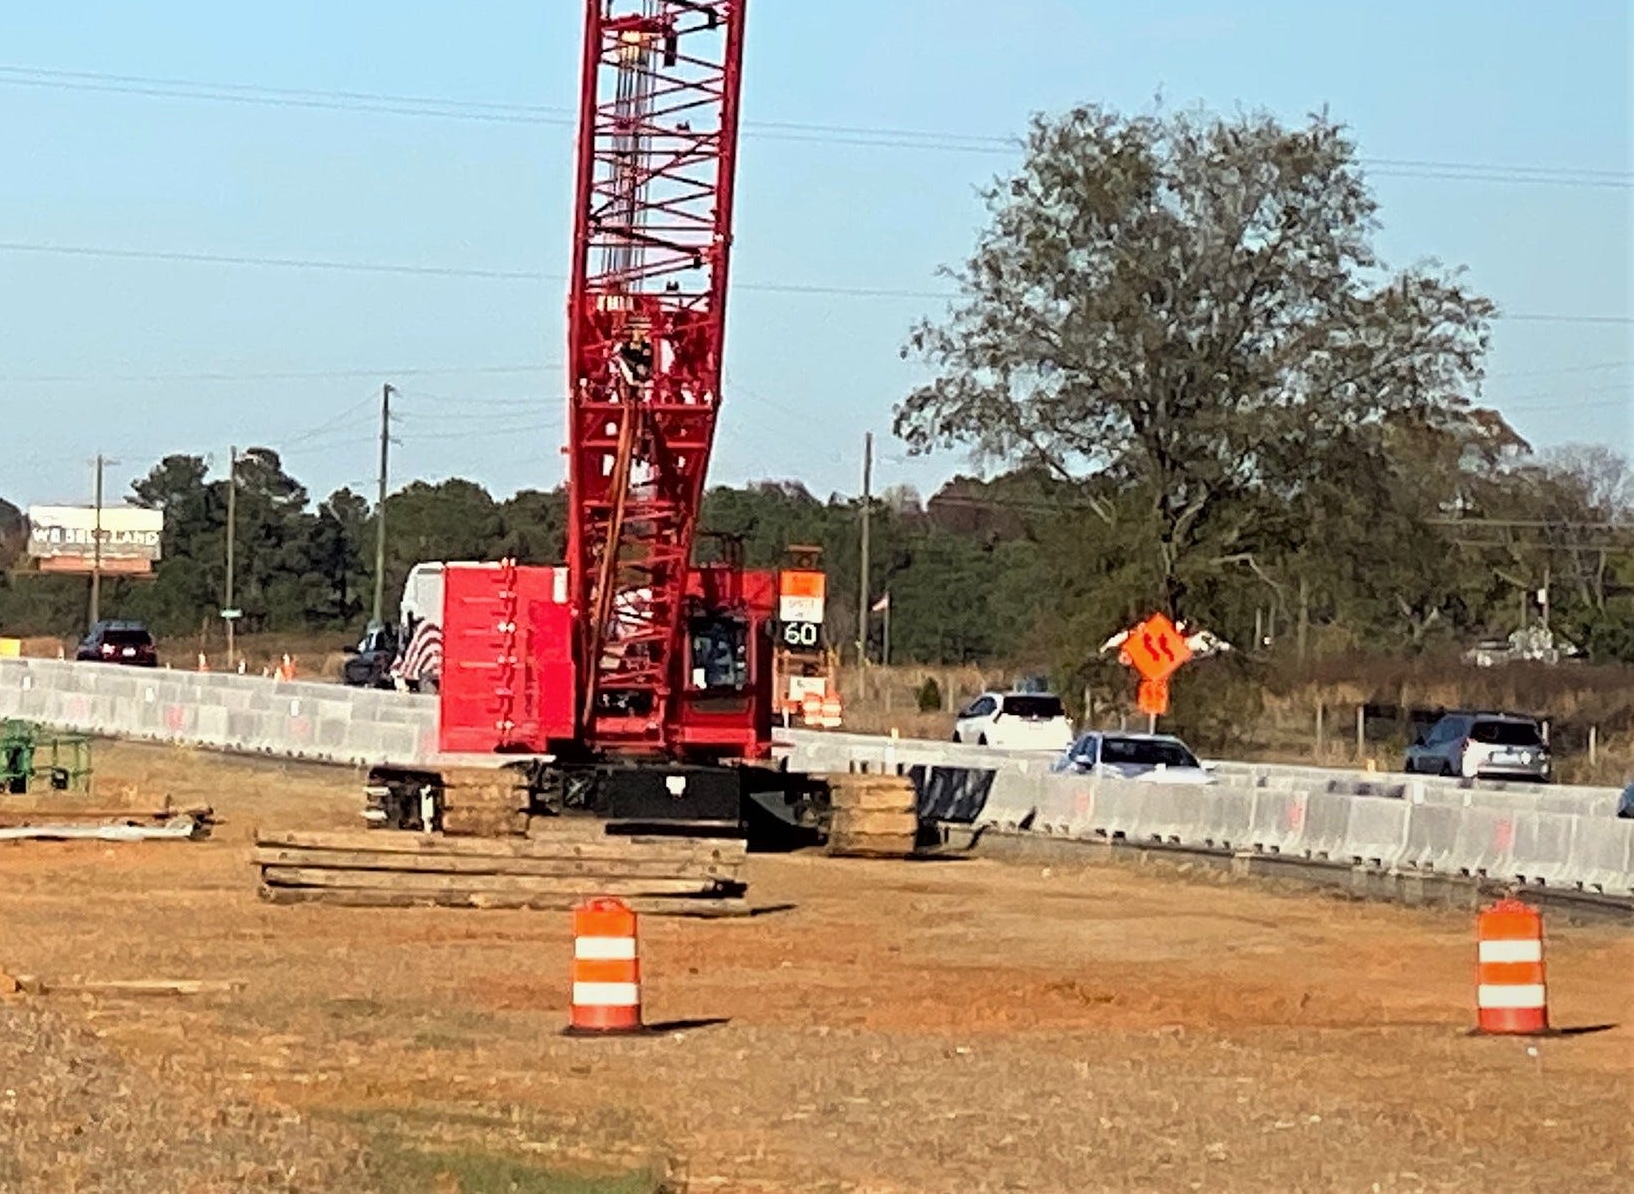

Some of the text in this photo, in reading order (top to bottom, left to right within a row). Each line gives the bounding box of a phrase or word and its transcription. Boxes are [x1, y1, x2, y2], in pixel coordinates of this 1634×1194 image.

[32, 527, 61, 543] WE
[109, 529, 160, 545] LAND
[784, 622, 817, 646] 60
